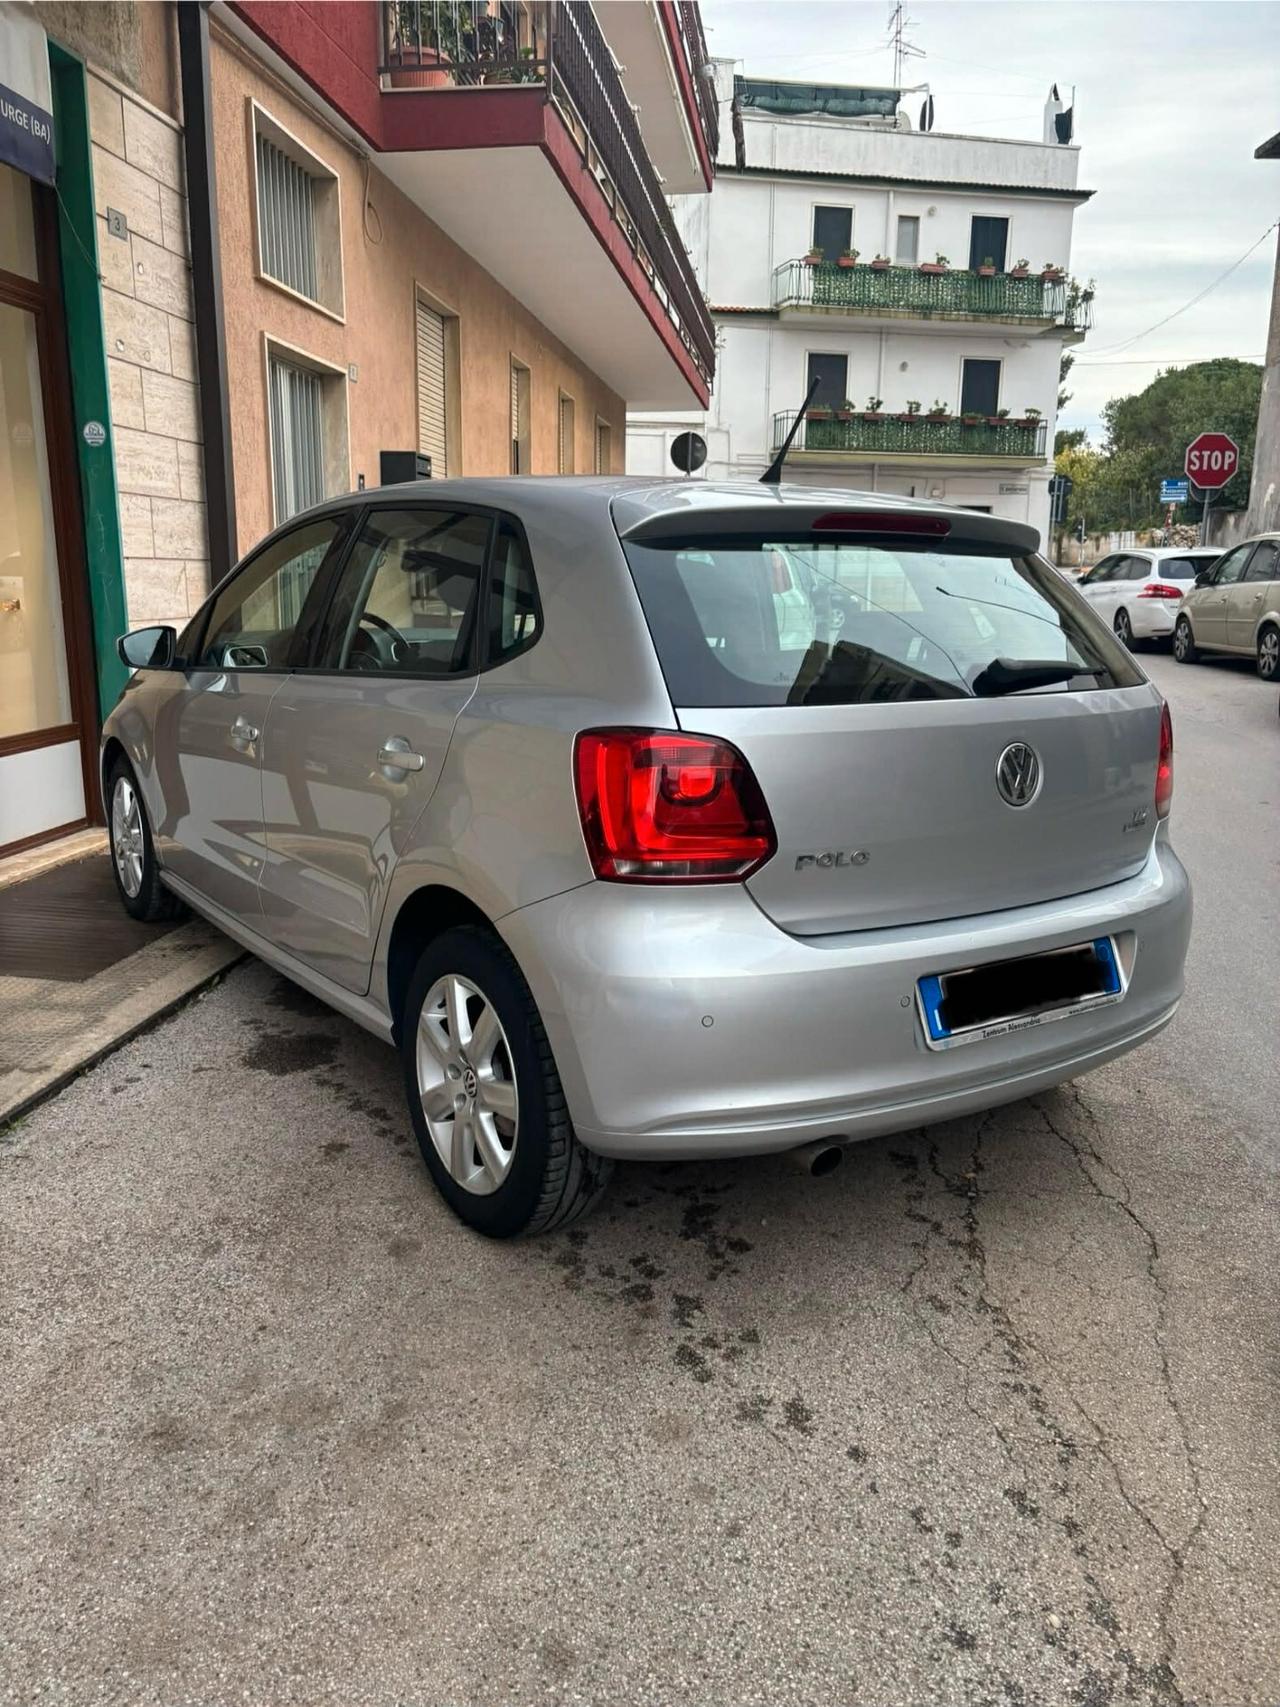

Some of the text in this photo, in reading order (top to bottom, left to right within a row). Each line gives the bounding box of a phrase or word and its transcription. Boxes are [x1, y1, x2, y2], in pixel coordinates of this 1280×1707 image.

[30, 115, 51, 145] (BA)
[1190, 450, 1236, 471] STOP
[795, 850, 870, 871] POLO
[982, 1025, 1007, 1039] Zentrum
